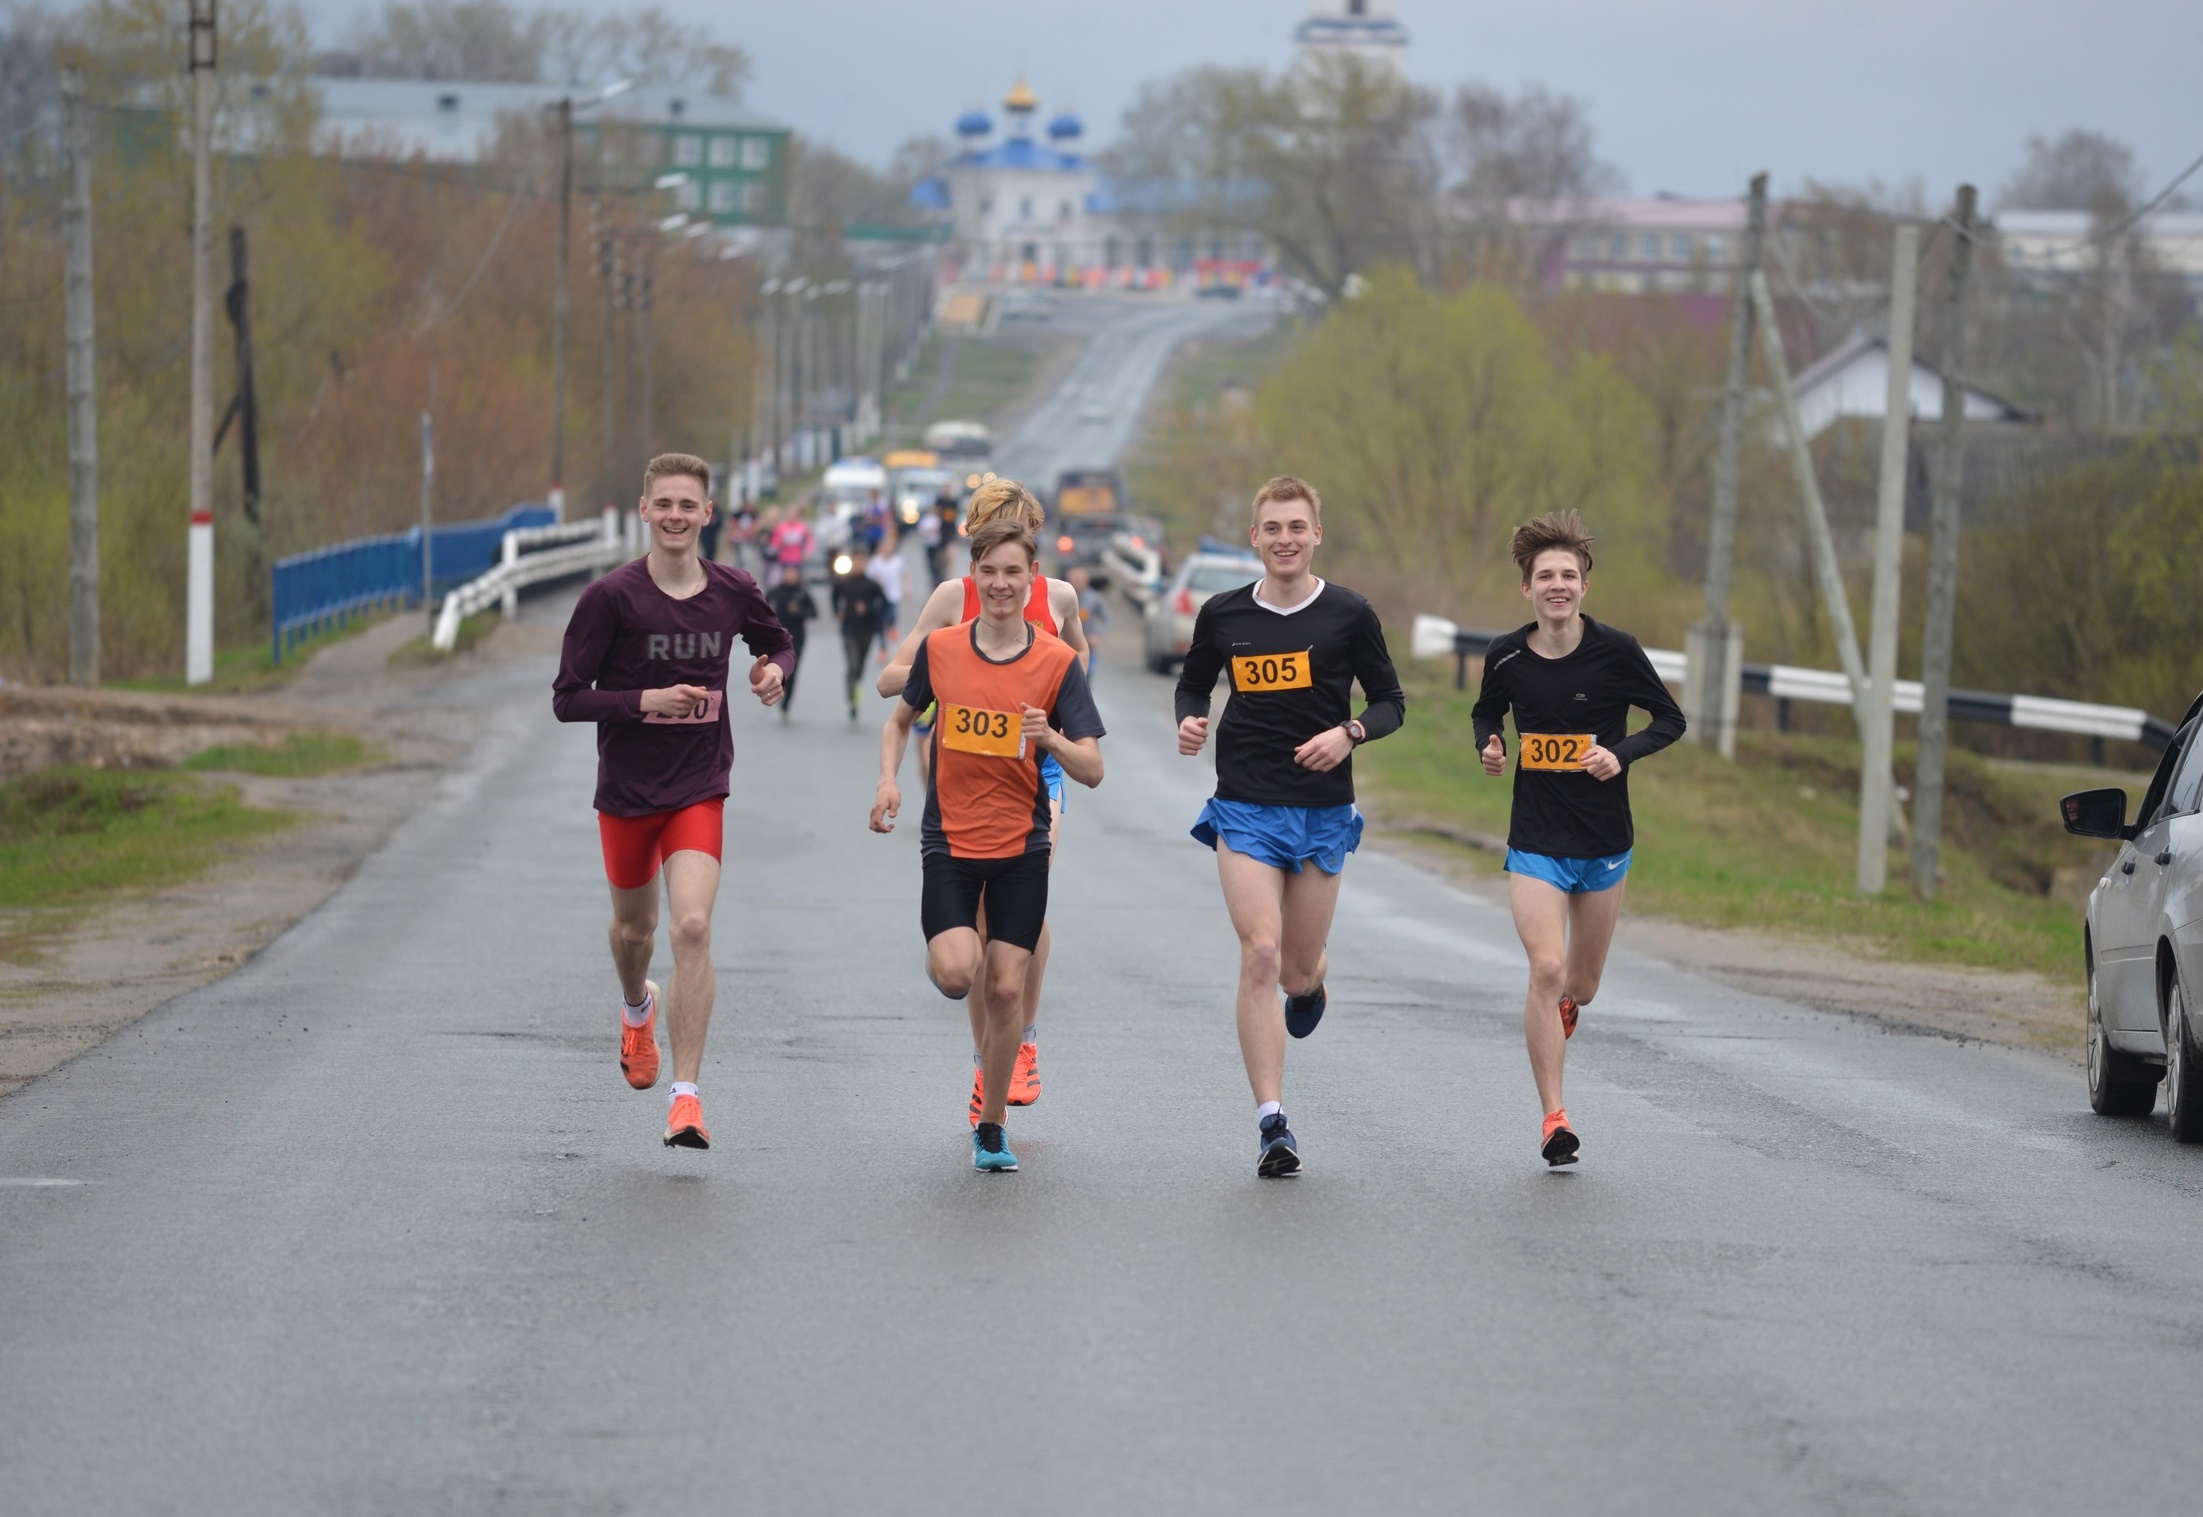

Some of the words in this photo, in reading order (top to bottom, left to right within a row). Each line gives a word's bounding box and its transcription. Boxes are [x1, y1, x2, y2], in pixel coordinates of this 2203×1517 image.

[648, 631, 722, 661] RUN
[1244, 656, 1297, 685] 305
[955, 708, 1008, 739] 303
[1531, 738, 1578, 763] 302
